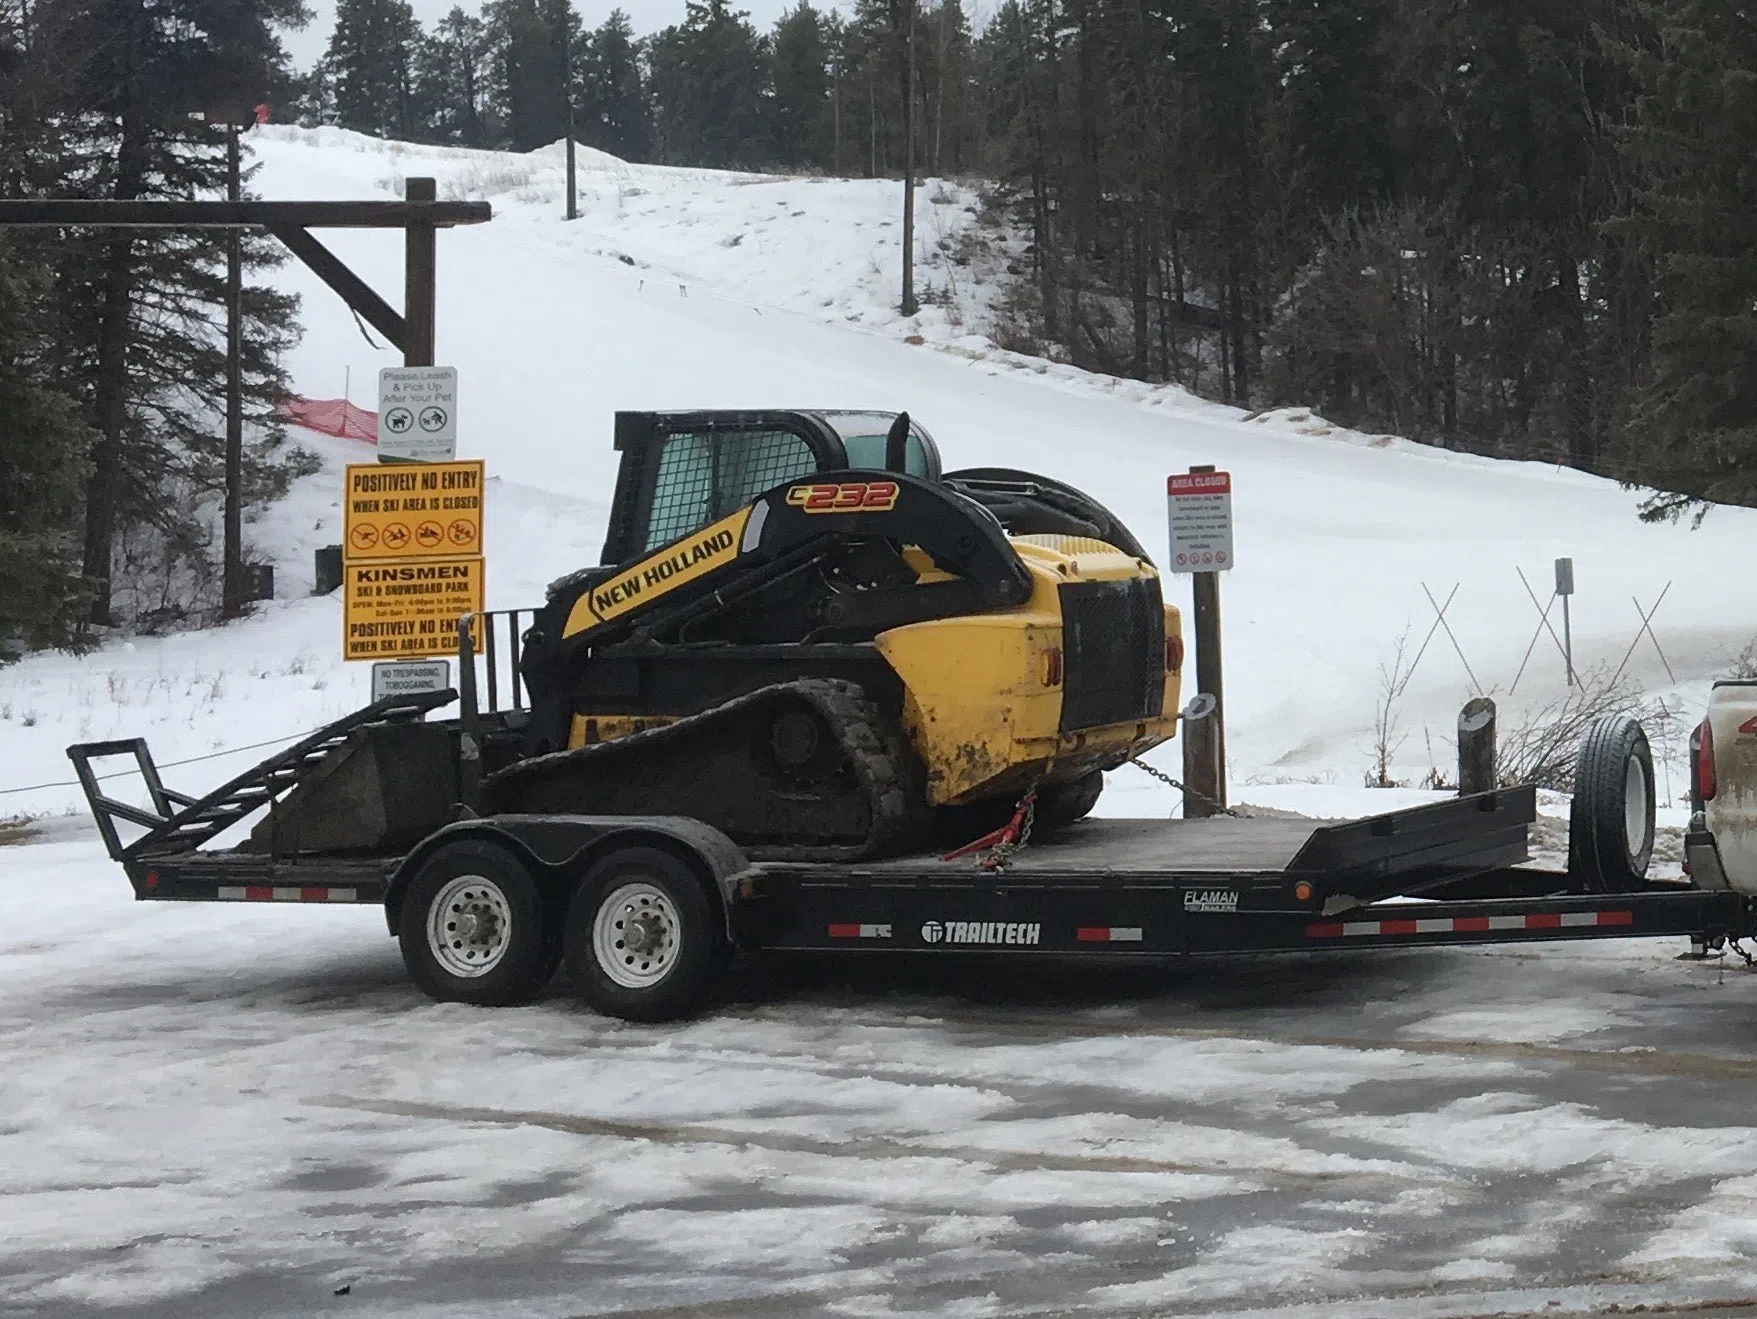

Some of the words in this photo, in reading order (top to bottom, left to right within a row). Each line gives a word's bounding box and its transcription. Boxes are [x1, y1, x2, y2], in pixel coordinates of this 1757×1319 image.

[393, 383, 400, 392] &
[403, 382, 424, 391] Pick
[427, 382, 443, 392] Up
[382, 394, 406, 403] After
[435, 393, 452, 401] Pet
[353, 472, 418, 493] POSITIVELY
[421, 472, 438, 491] NO
[441, 470, 478, 490] ENTRY
[1172, 478, 1194, 489] AREA
[1194, 476, 1227, 487] CLOSED
[353, 500, 380, 513] WHEN
[382, 498, 400, 513] SKI
[402, 497, 427, 511] AREA
[430, 497, 440, 510] IS
[442, 496, 478, 510] CLOSED
[357, 565, 469, 582] KINSMEN
[595, 575, 642, 612] NEW
[646, 529, 734, 587] HOLLAND
[356, 586, 373, 597] SKI
[375, 585, 382, 596] &
[385, 582, 443, 596] SNOWBOARD
[445, 581, 469, 592] PARK
[350, 621, 415, 637] POSITIVELY
[419, 619, 436, 634] NO
[440, 618, 476, 633] ENTY
[350, 640, 377, 653] WHEN
[380, 639, 397, 652] SKI
[401, 638, 425, 650] AREA
[428, 637, 438, 649] IS
[381, 669, 391, 678] NO
[1184, 891, 1239, 905] FLAMAN
[945, 921, 1041, 944] TRAILTECH
